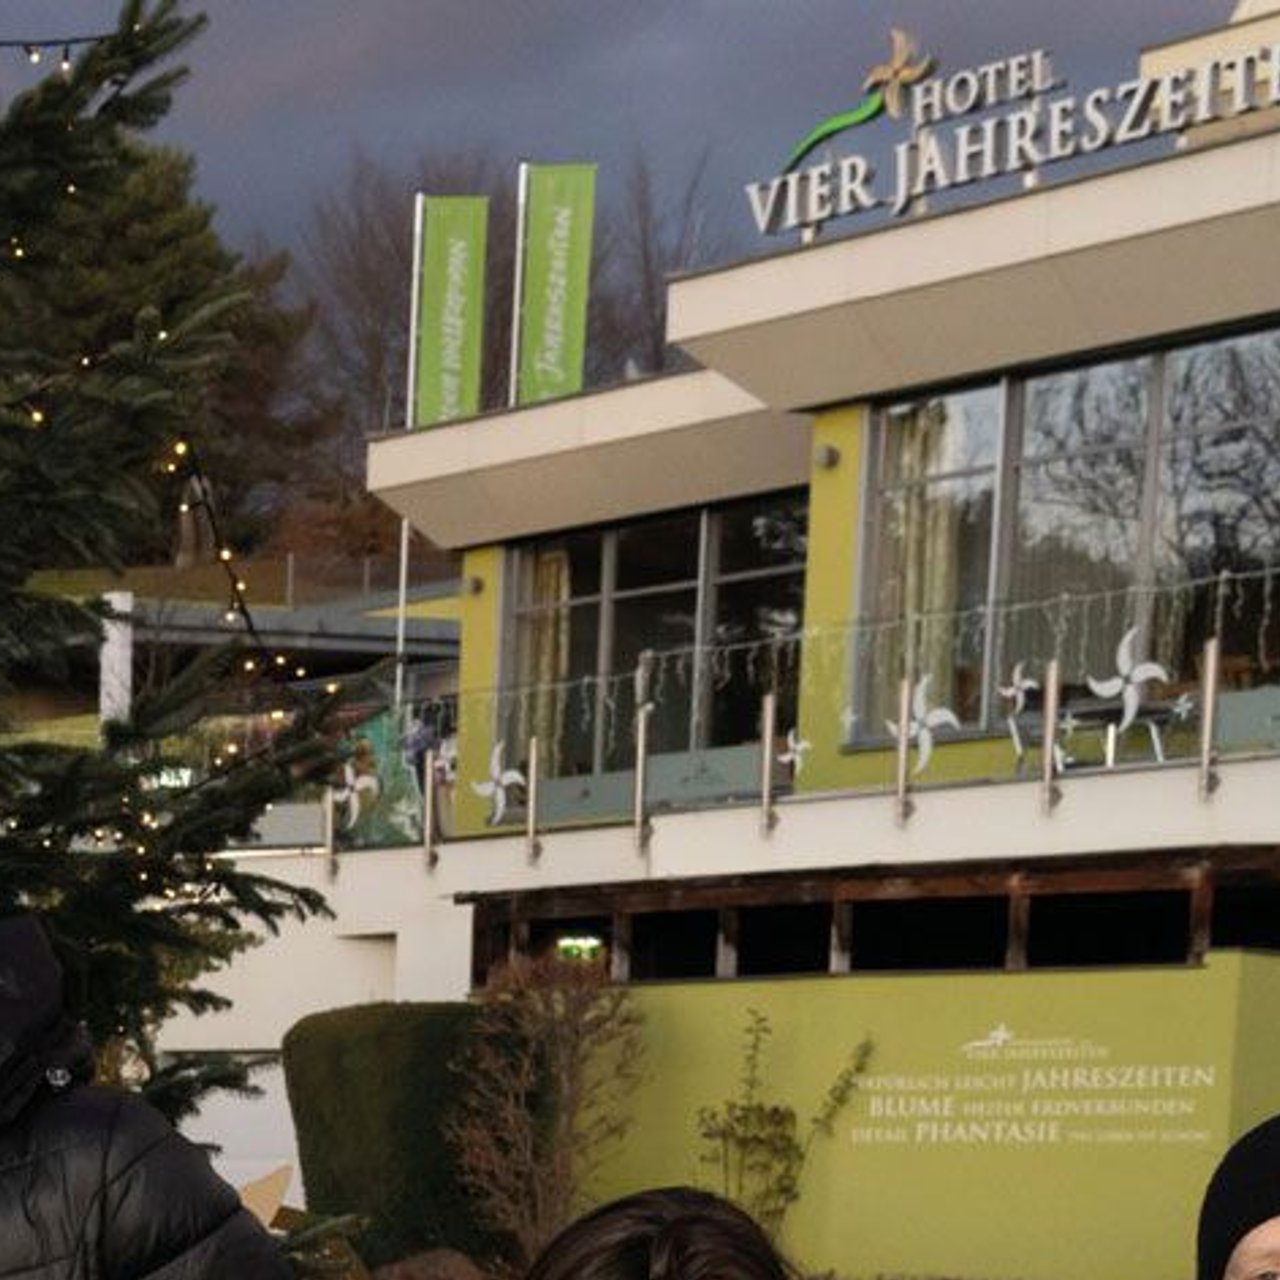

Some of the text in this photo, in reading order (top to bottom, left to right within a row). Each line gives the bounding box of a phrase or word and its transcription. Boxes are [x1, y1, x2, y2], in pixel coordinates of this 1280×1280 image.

[913, 50, 1056, 127] HOTEL
[744, 45, 1280, 234] VIER JAHRESZEIT
[1022, 1064, 1215, 1094] JAHRESZEITEN
[870, 1096, 955, 1117] BLUME
[915, 1121, 1062, 1143] PHANTASIE
